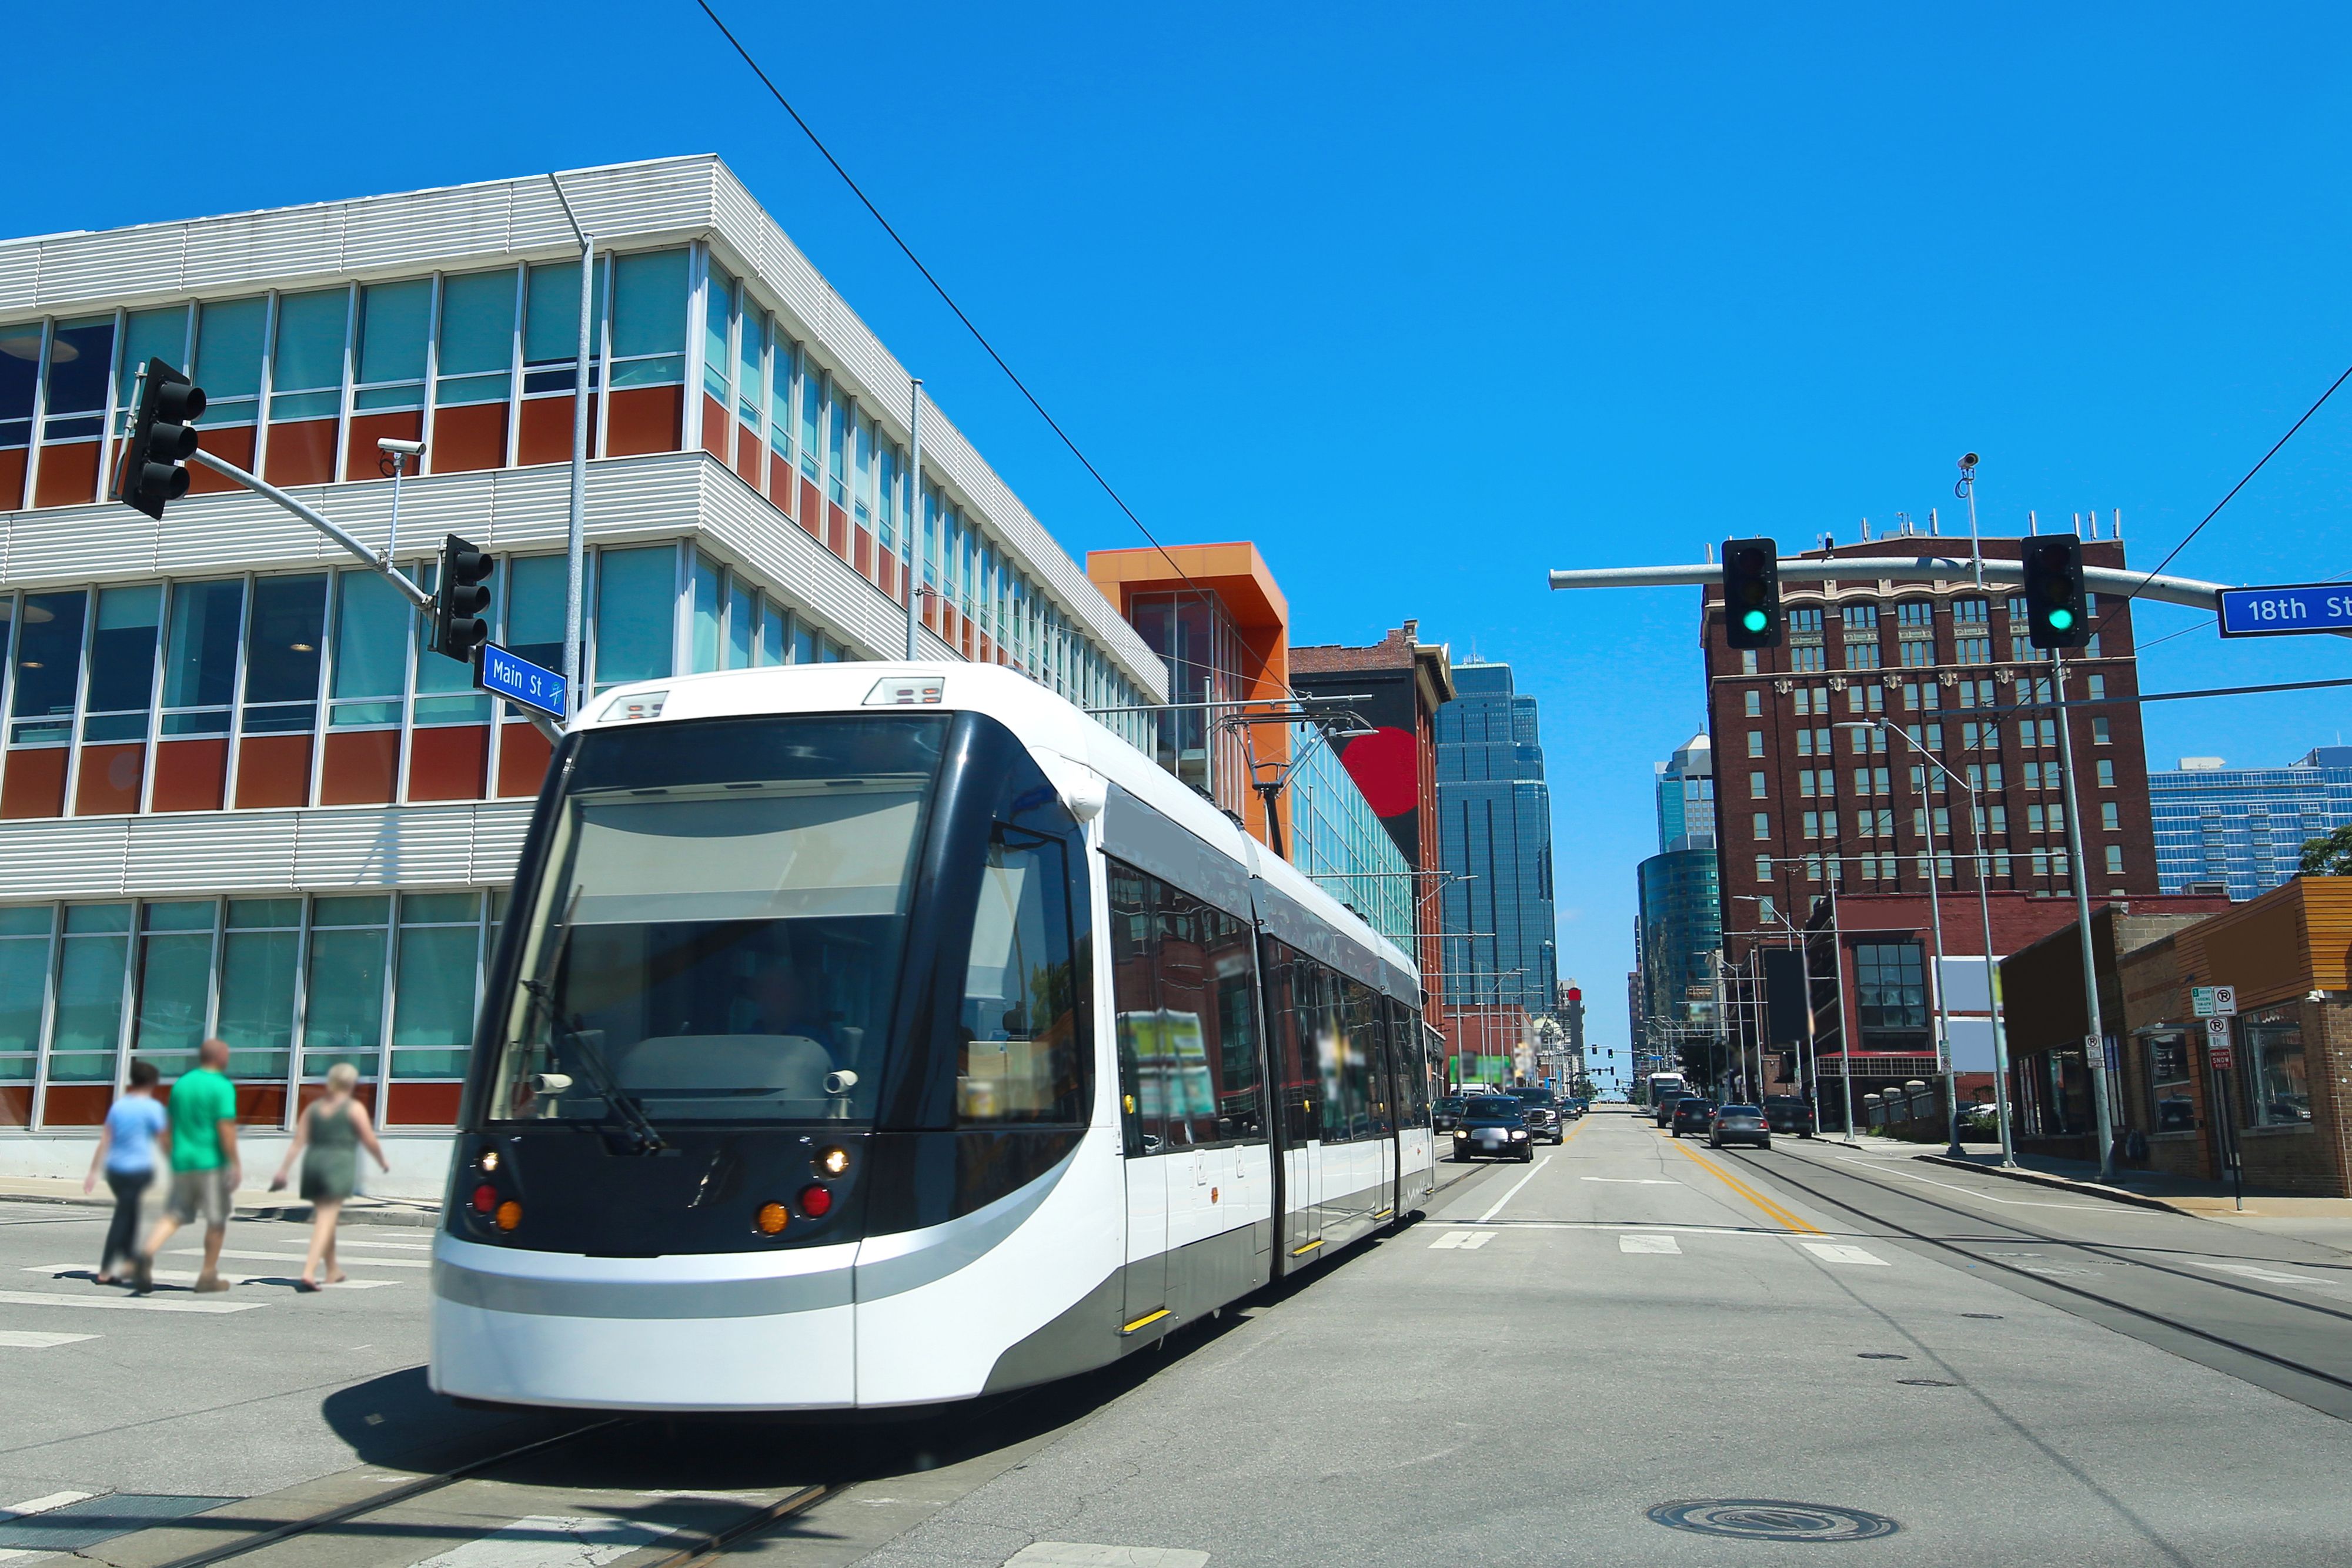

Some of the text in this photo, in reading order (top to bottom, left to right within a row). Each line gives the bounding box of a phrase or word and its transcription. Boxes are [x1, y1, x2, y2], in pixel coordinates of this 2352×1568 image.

[2249, 596, 2352, 620] 18th St
[493, 658, 542, 697] Main St
